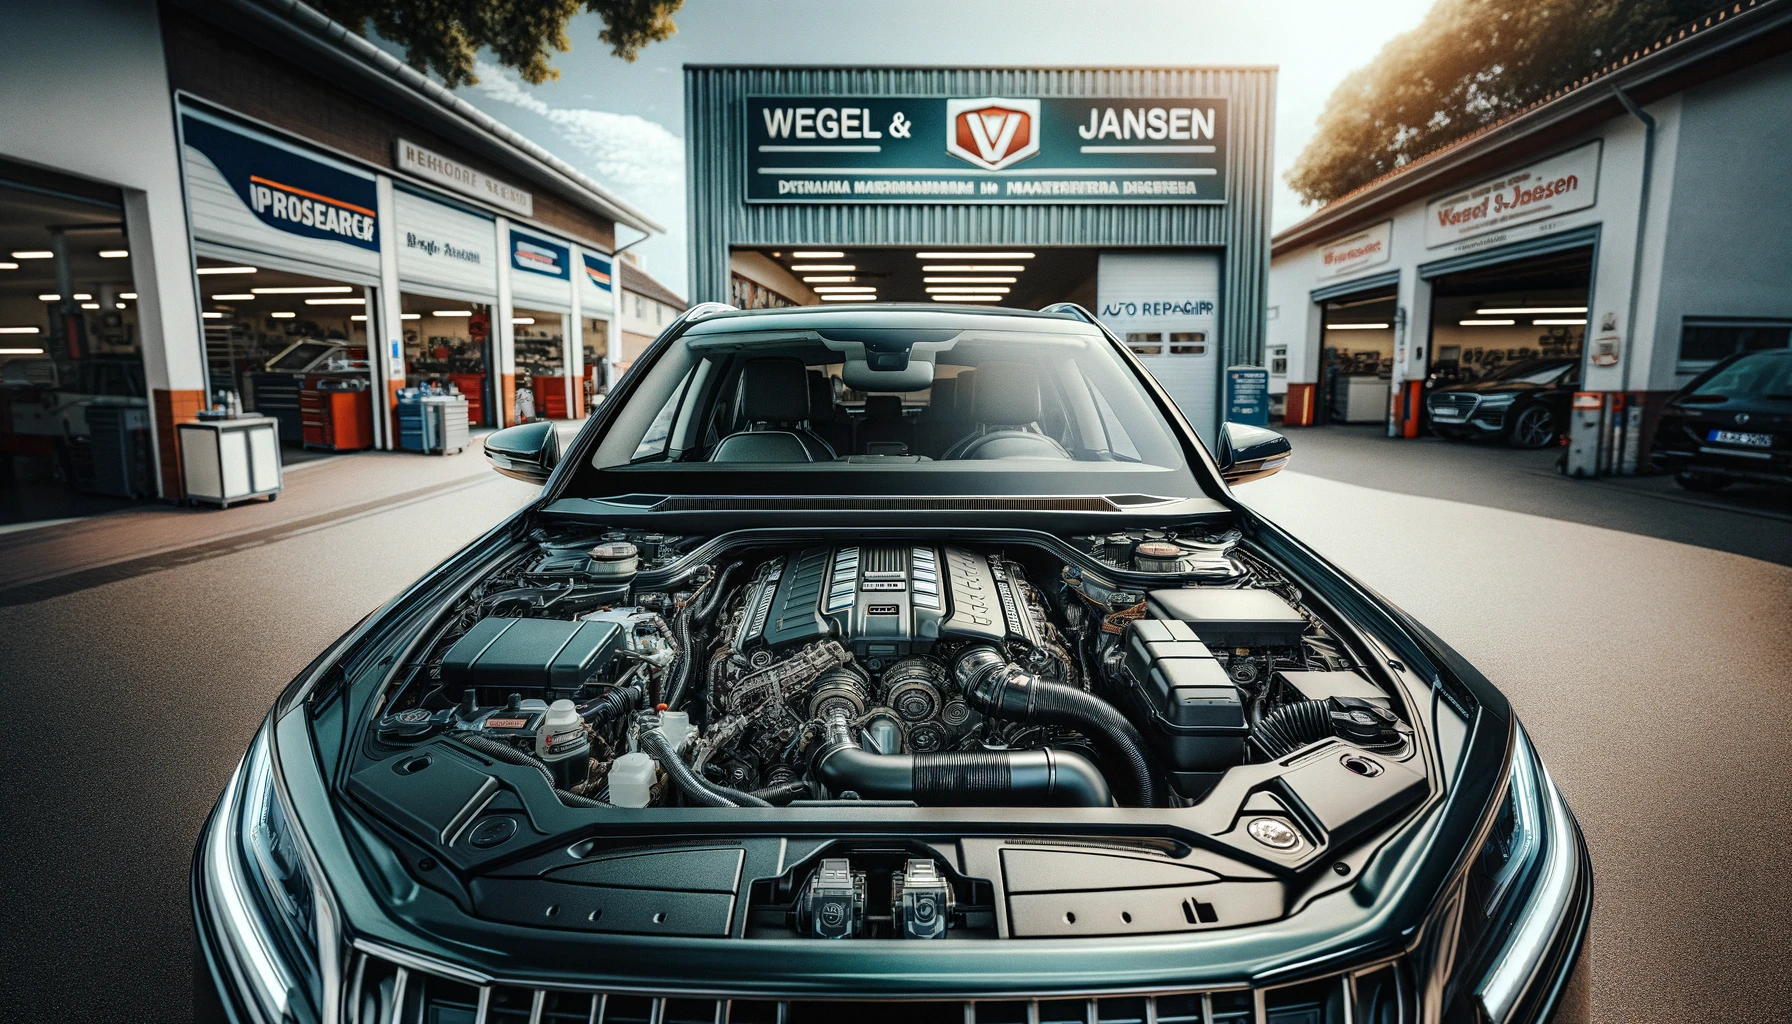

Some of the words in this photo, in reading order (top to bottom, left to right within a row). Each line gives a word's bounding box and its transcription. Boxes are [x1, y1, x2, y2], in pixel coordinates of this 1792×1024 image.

[763, 107, 882, 139] WEGEL
[889, 111, 912, 139] &
[1078, 107, 1216, 140] JANSEN
